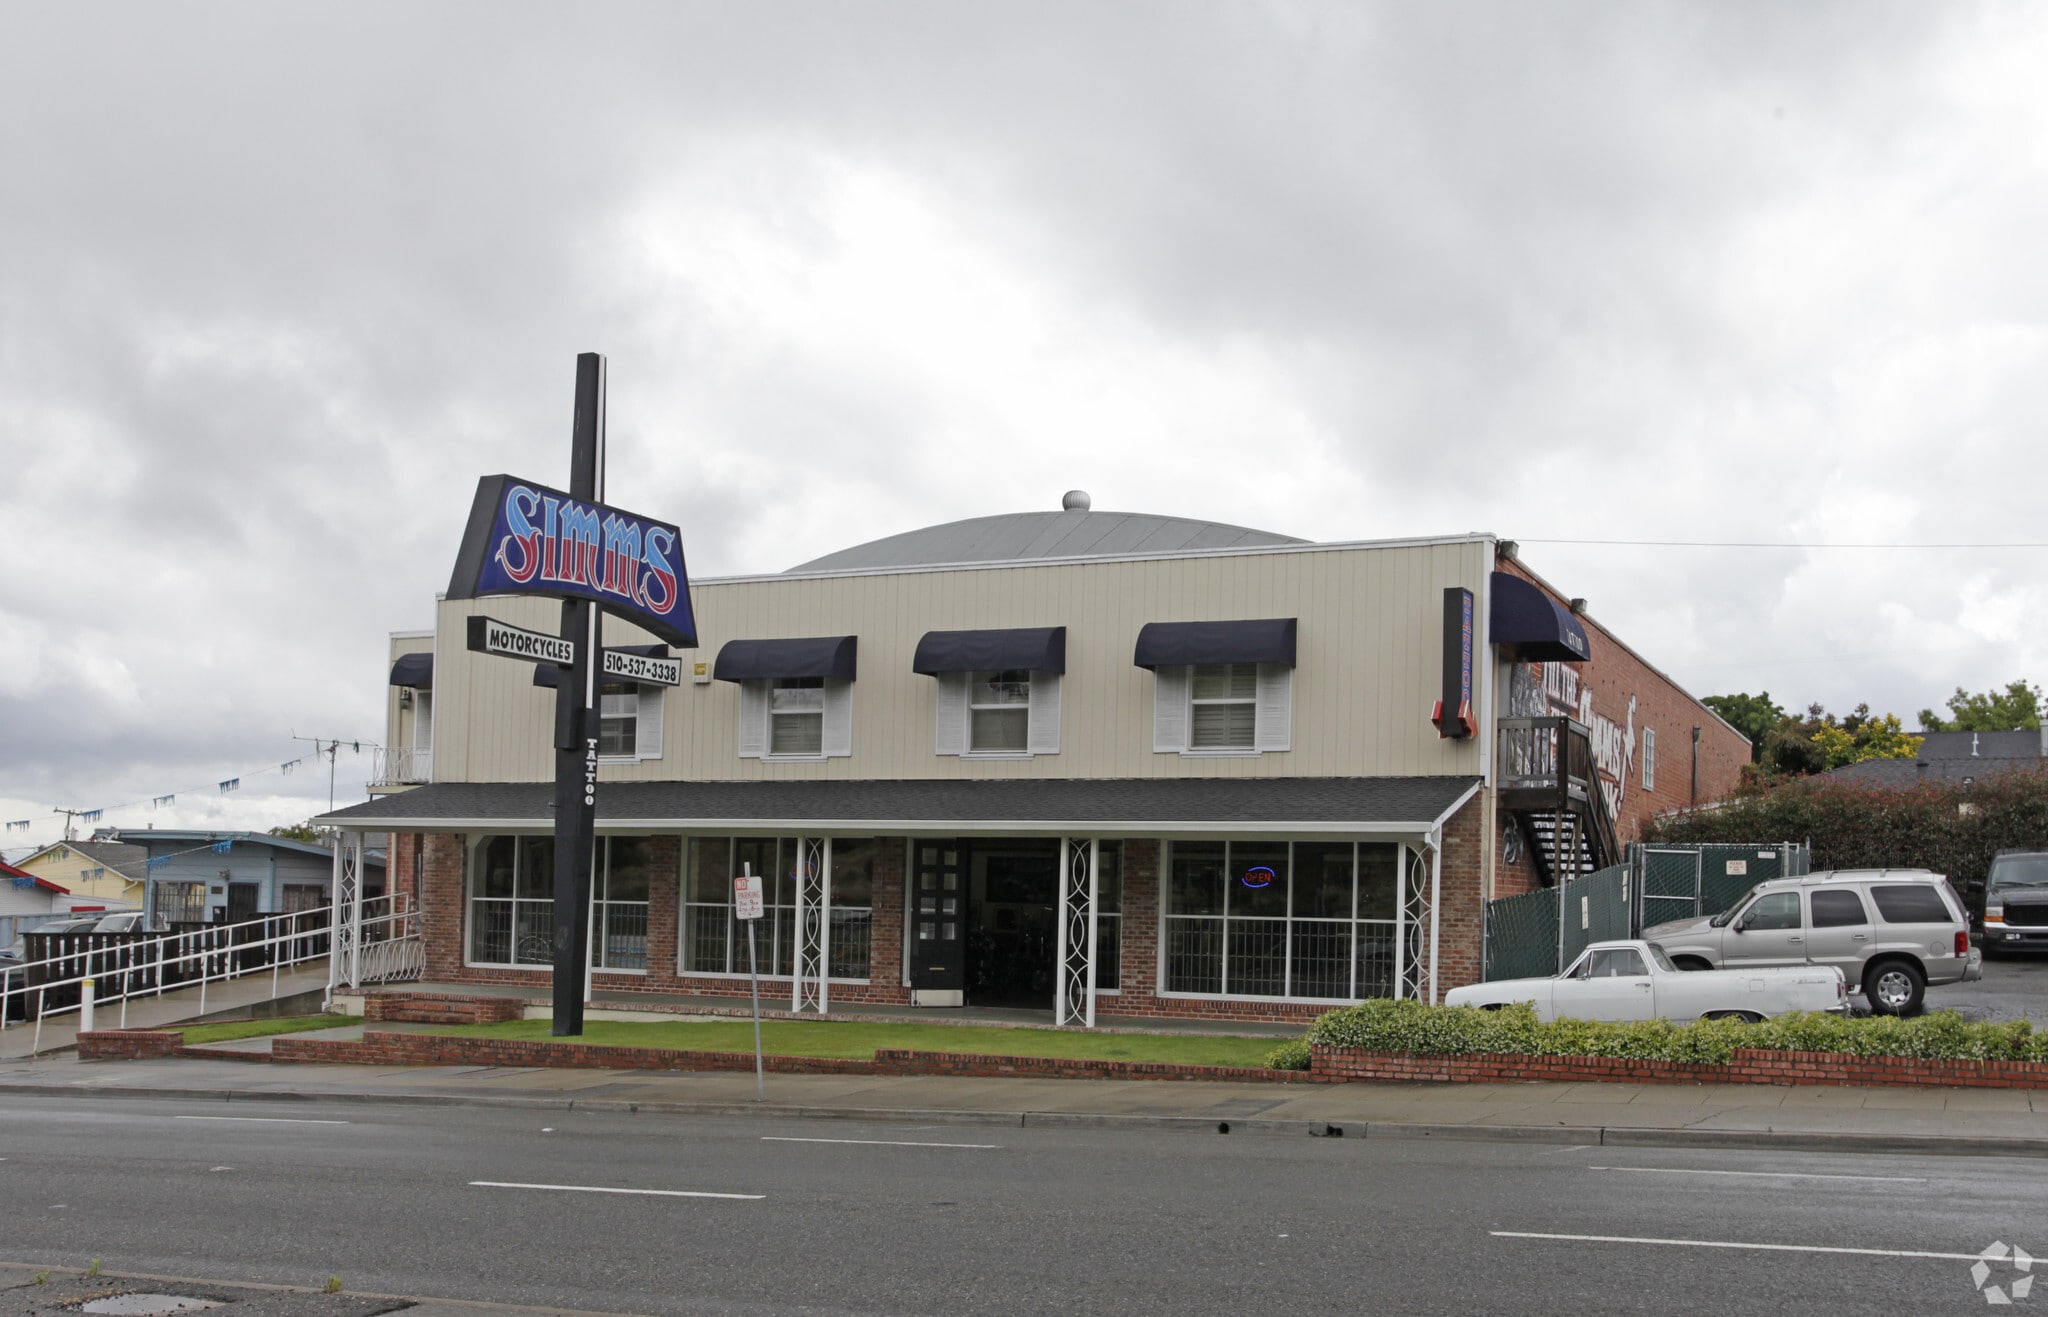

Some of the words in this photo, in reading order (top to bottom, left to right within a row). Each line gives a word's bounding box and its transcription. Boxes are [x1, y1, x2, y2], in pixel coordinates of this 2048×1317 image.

[495, 485, 678, 615] SIMMS
[489, 628, 572, 661] MOTORCYCLES
[605, 653, 678, 682] 510-537-3338
[585, 738, 598, 806] TATTOO
[737, 879, 747, 890] NO
[1245, 872, 1272, 883] OPEN
[737, 891, 760, 899] PARKING
